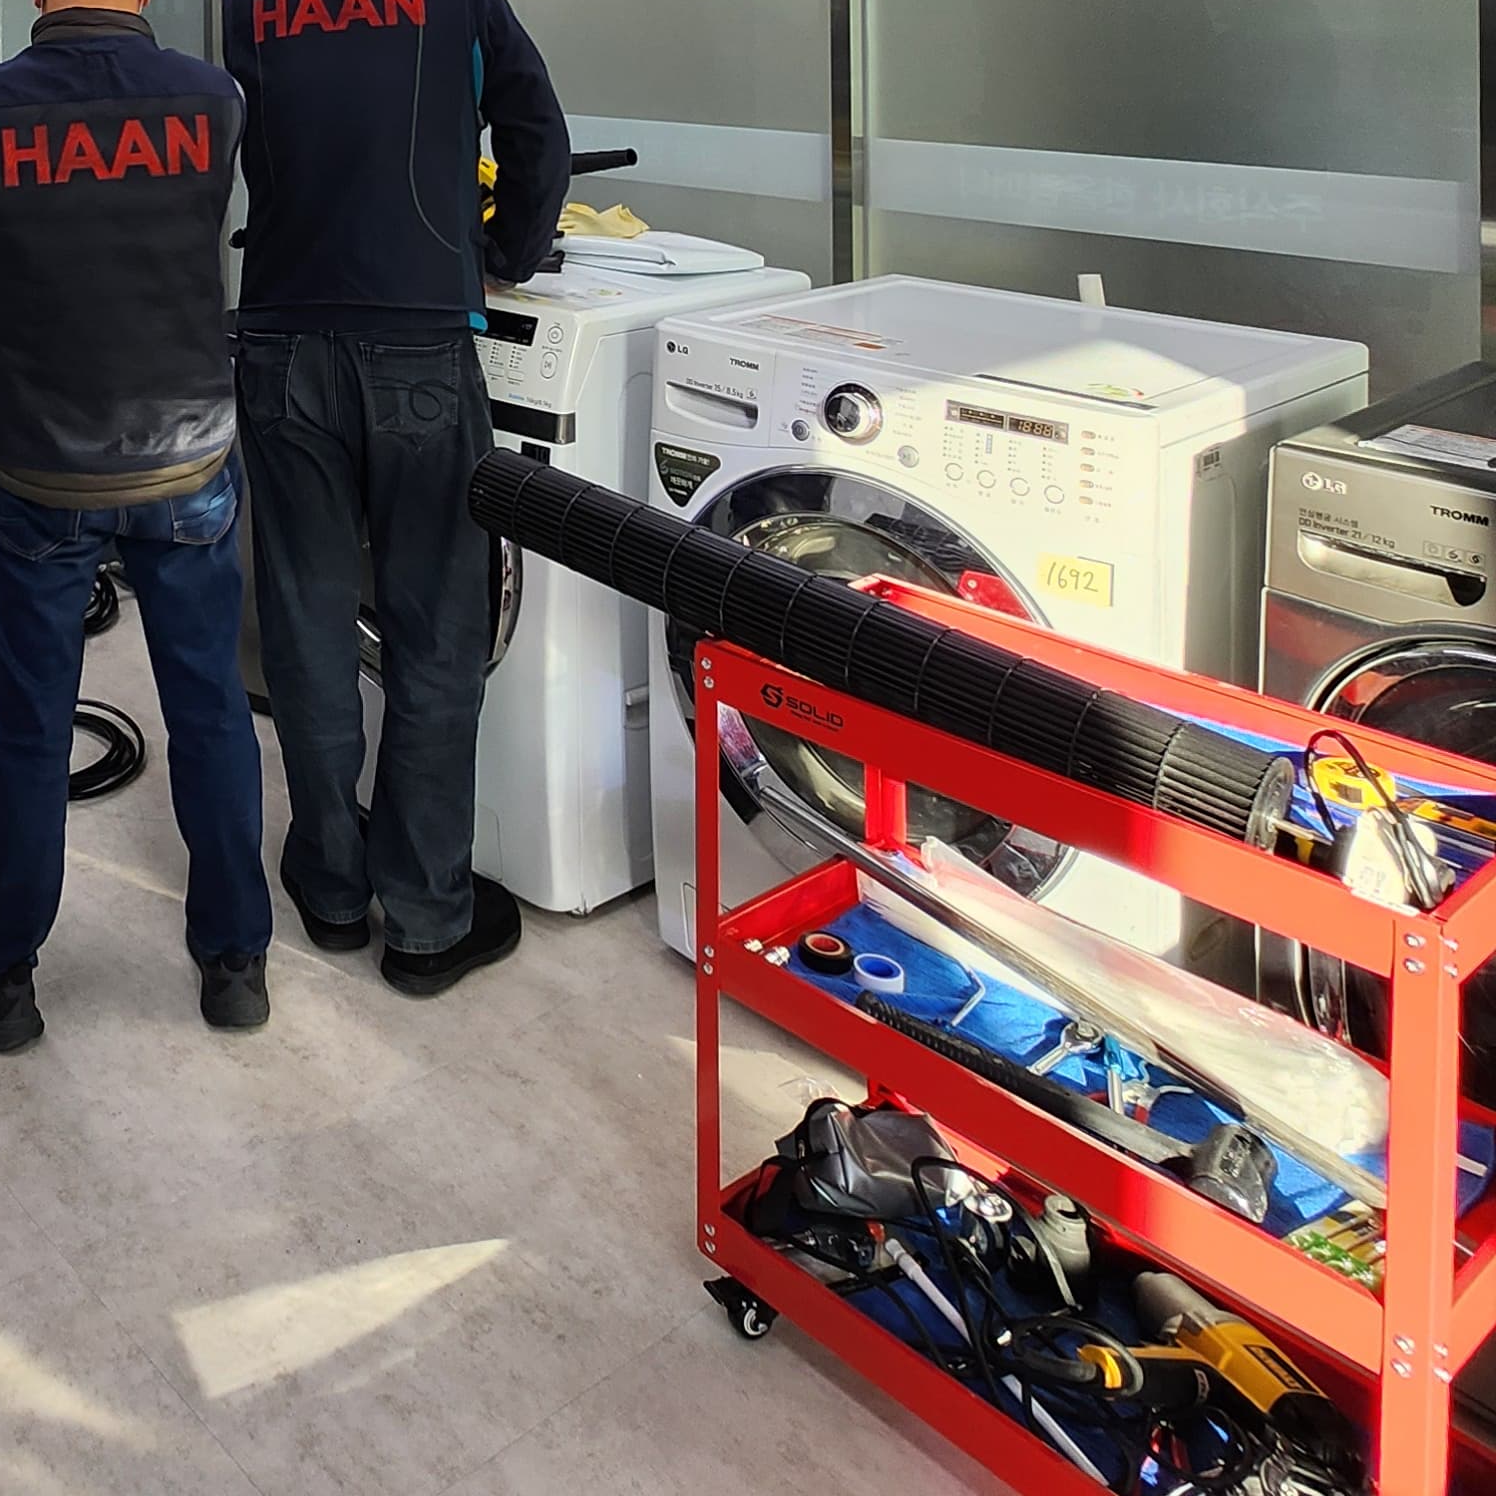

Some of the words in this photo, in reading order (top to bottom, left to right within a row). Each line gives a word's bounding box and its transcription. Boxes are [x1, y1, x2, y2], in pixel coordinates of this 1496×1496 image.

[1, 114, 211, 188] HAAN
[729, 357, 760, 371] TROMM
[1324, 478, 1347, 495] LG
[1299, 516, 1311, 528] DD
[1313, 519, 1349, 536] Inverter
[1430, 505, 1490, 527] TROMM
[1046, 561, 1099, 593] 1692
[785, 696, 844, 728] SOLID
